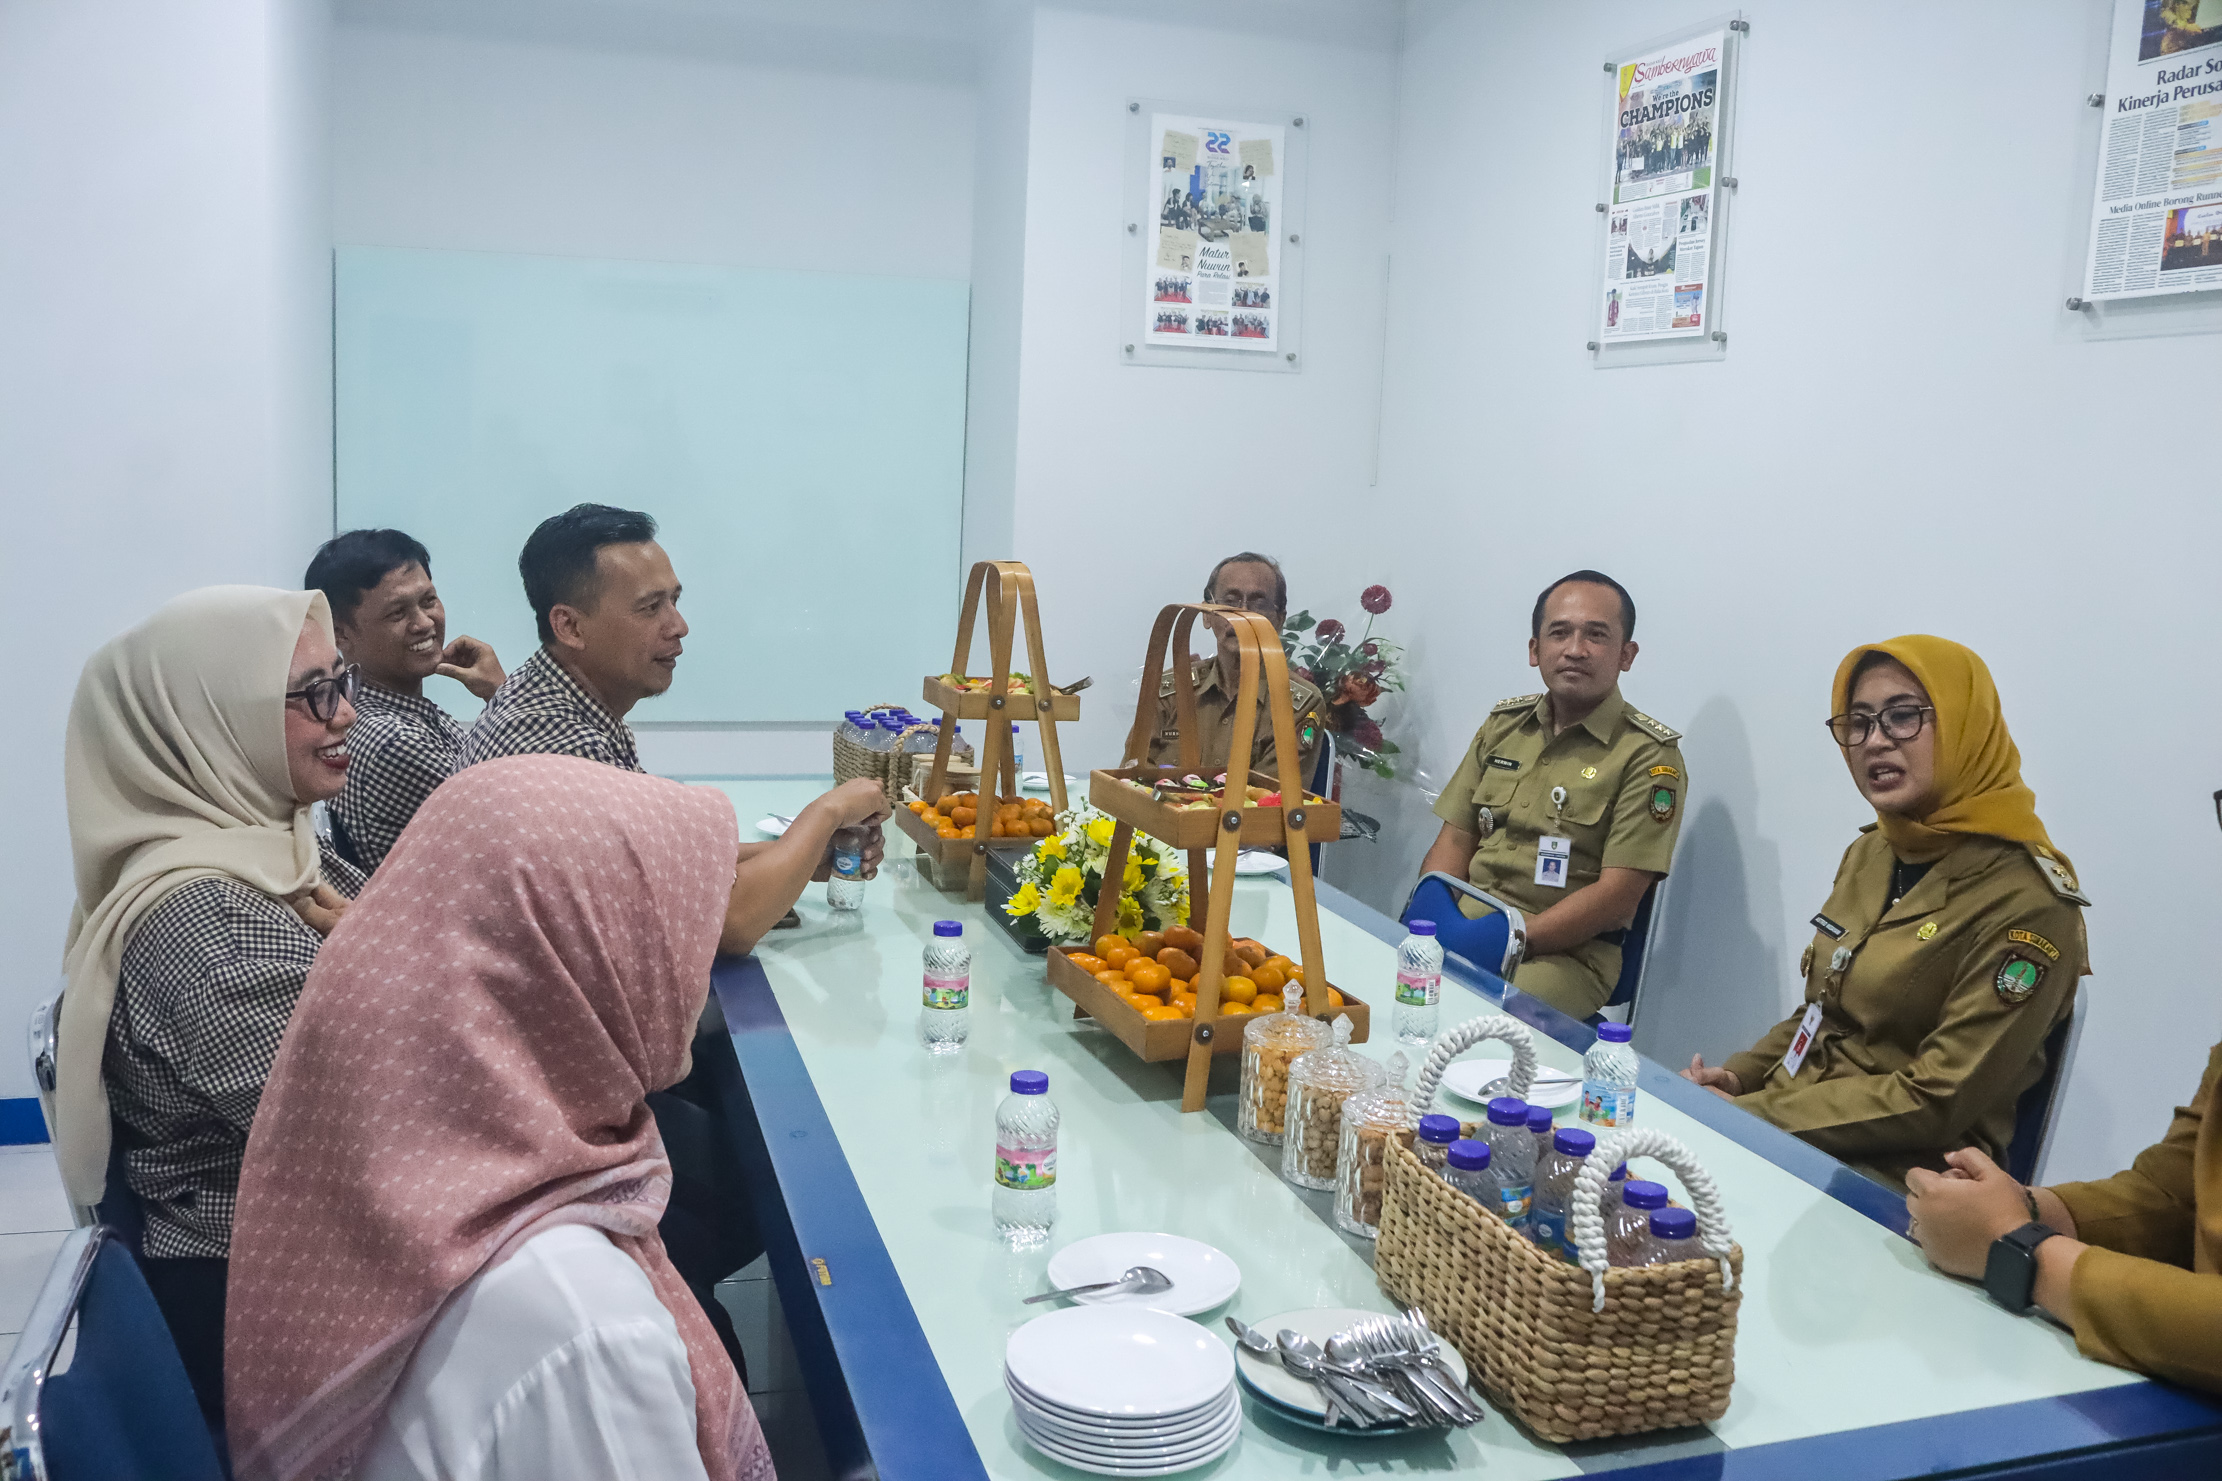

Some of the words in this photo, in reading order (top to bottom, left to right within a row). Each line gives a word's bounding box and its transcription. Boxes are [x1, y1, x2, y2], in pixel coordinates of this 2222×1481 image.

[2157, 65, 2202, 85] Radar
[1669, 90, 1679, 98] the
[2118, 90, 2169, 113] Kinerja
[1620, 87, 1713, 128] CHAMPIONS
[1205, 131, 1231, 154] 22
[2109, 203, 2133, 214] Media
[2134, 200, 2161, 211] Online
[2163, 195, 2194, 205] Borong
[1199, 246, 1230, 259] Matur
